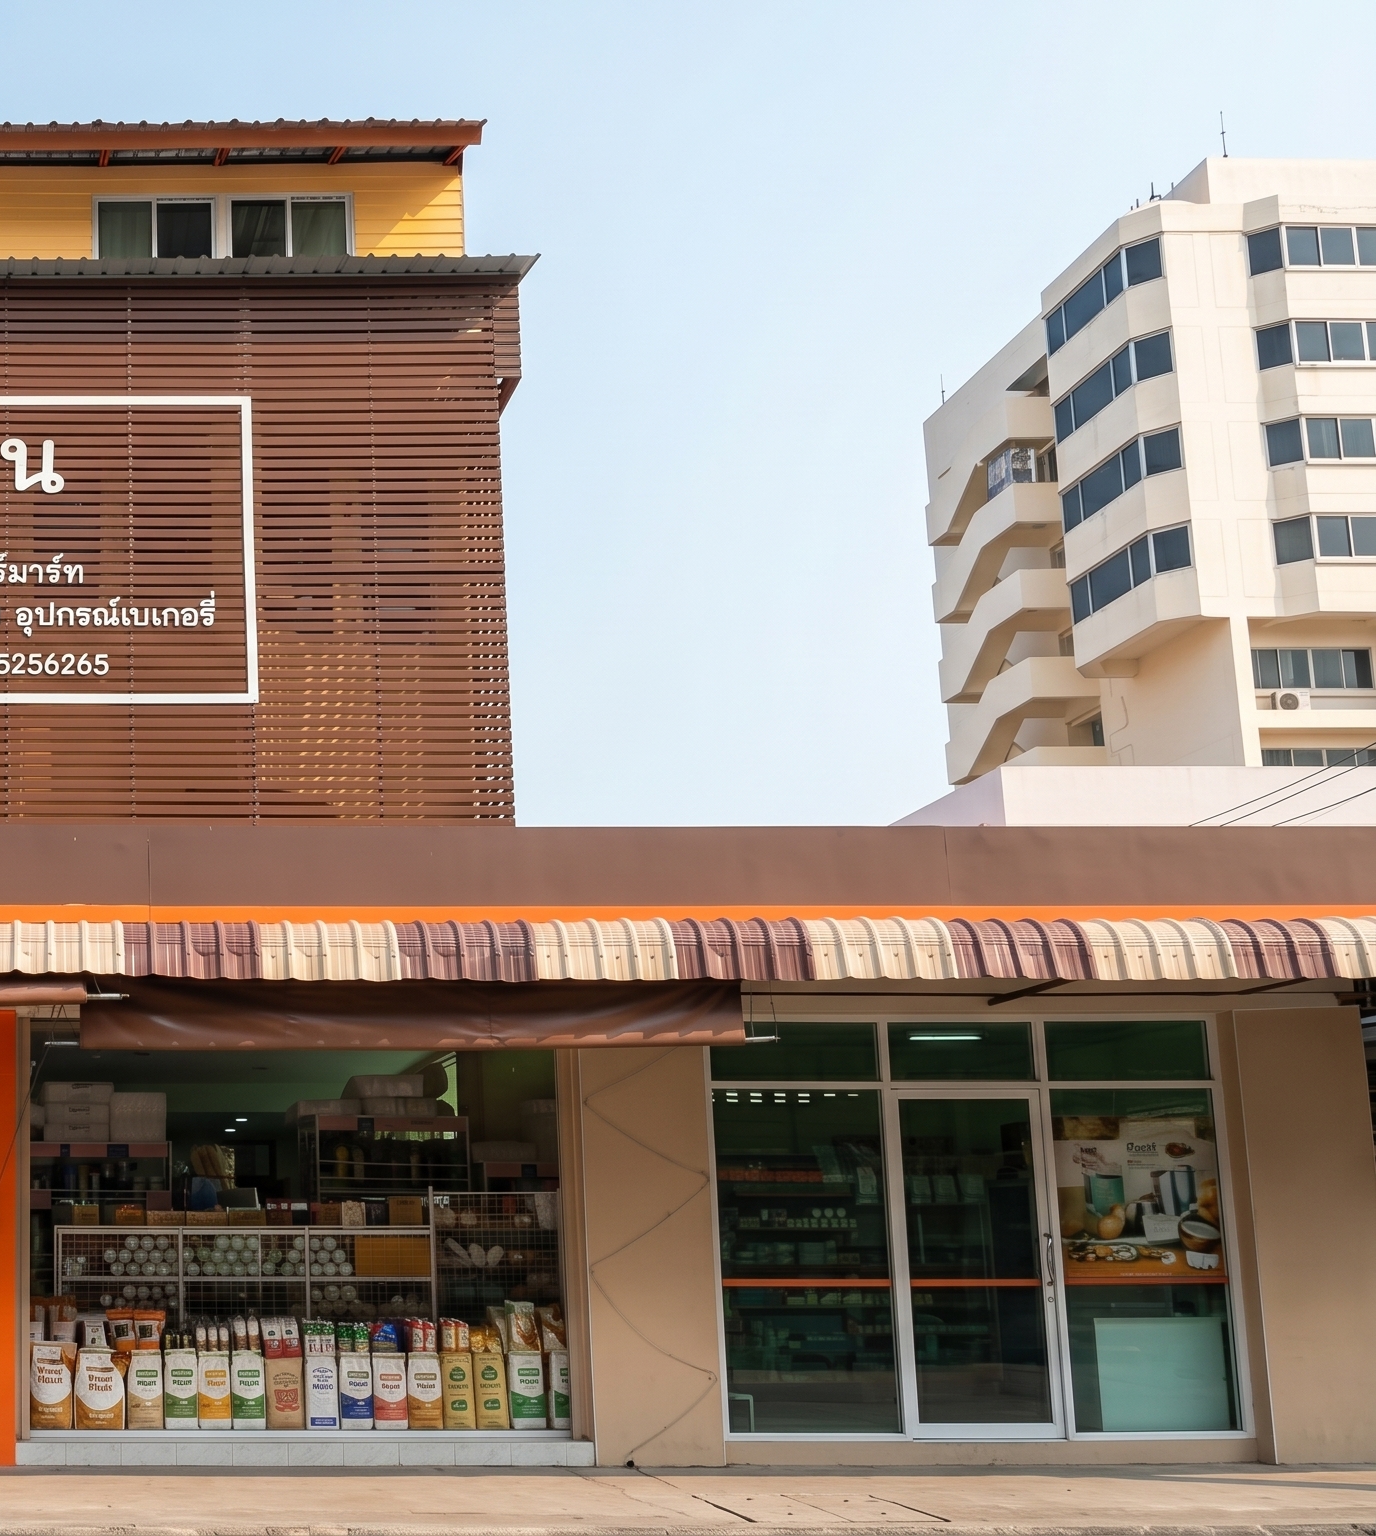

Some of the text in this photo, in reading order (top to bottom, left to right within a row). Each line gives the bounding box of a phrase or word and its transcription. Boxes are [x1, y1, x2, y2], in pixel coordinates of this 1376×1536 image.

[15, 591, 216, 637] อุปกรณ์เบเกอรี่
